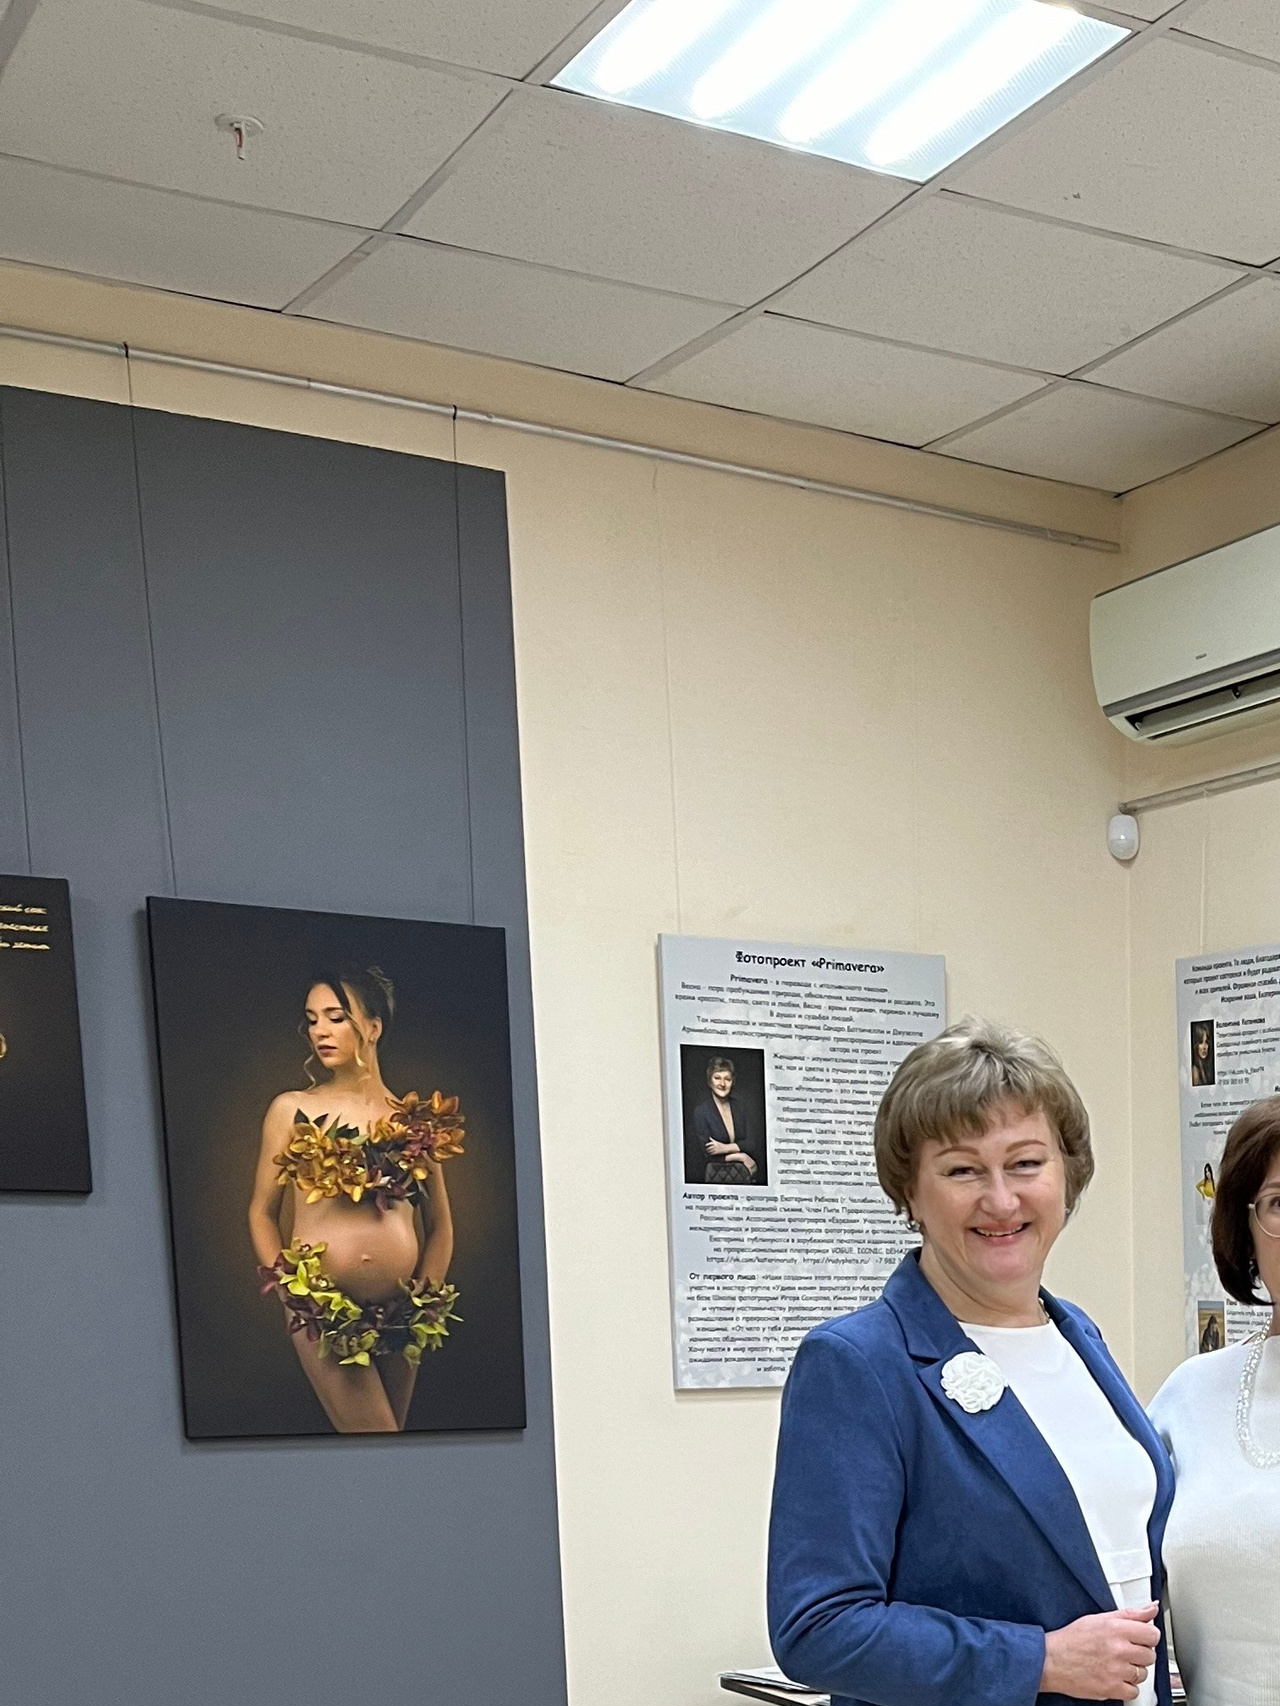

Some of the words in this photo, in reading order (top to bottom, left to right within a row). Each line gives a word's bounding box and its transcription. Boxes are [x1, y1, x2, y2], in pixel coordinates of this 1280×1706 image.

[735, 951, 806, 968] Фотопроект
[811, 957, 885, 973] «Primavera»
[730, 974, 768, 984] Primavera
[682, 1192, 705, 1201] Автор
